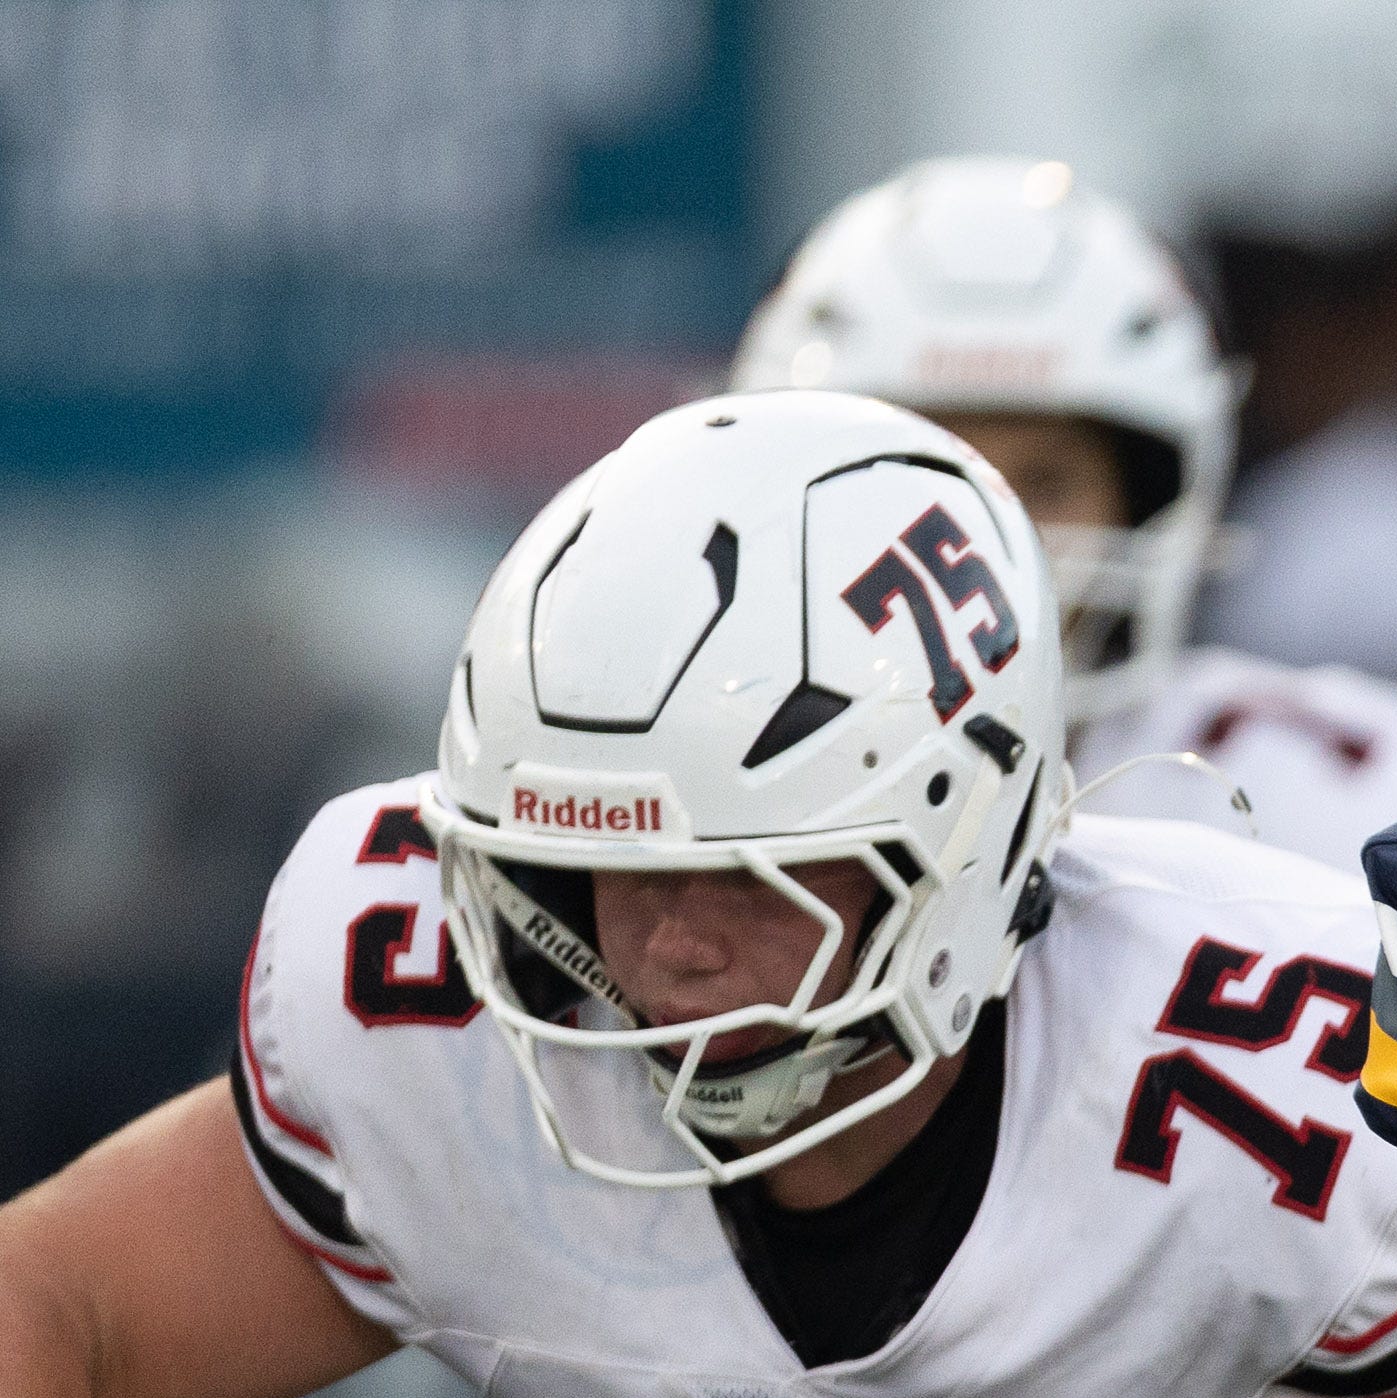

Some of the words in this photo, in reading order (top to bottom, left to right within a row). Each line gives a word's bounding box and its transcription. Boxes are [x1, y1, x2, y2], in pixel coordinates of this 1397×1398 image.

[840, 502, 1021, 725] 75
[513, 787, 662, 831] Riddell
[1114, 934, 1374, 1223] 75
